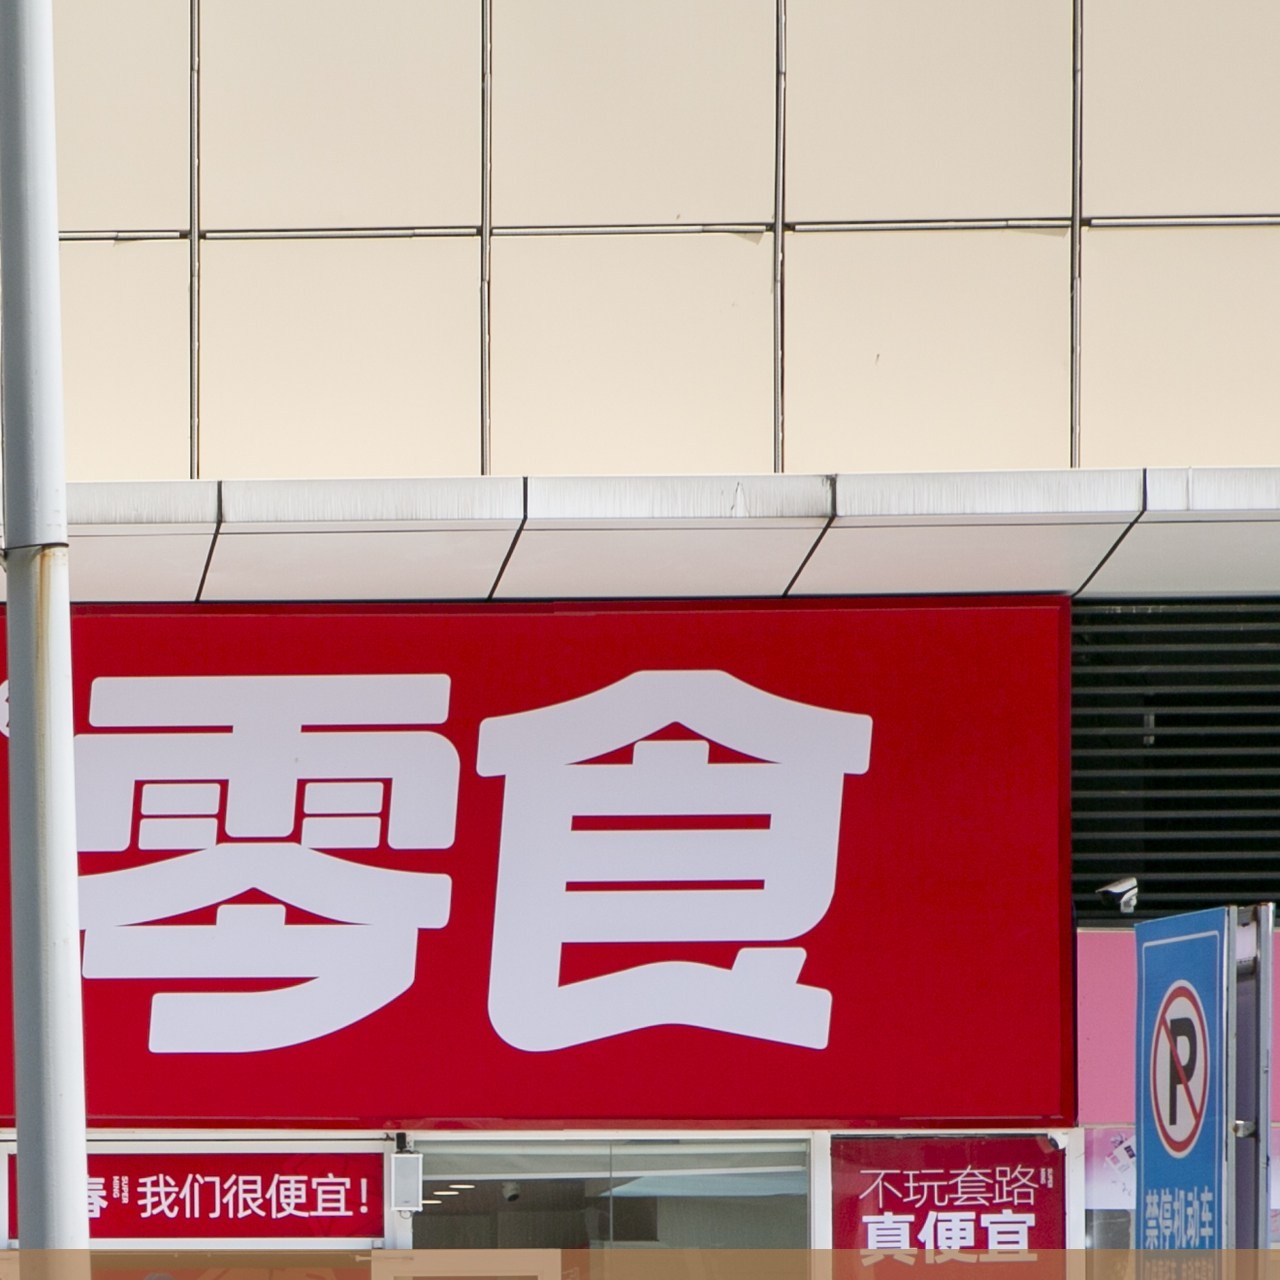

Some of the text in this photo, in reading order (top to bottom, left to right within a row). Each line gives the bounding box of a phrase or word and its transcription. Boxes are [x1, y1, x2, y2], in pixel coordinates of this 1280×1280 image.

[859, 1164, 1040, 1209] 不玩套路
[860, 1209, 1039, 1267] 真便宜
[1145, 1185, 1214, 1249] 禁停机动车
